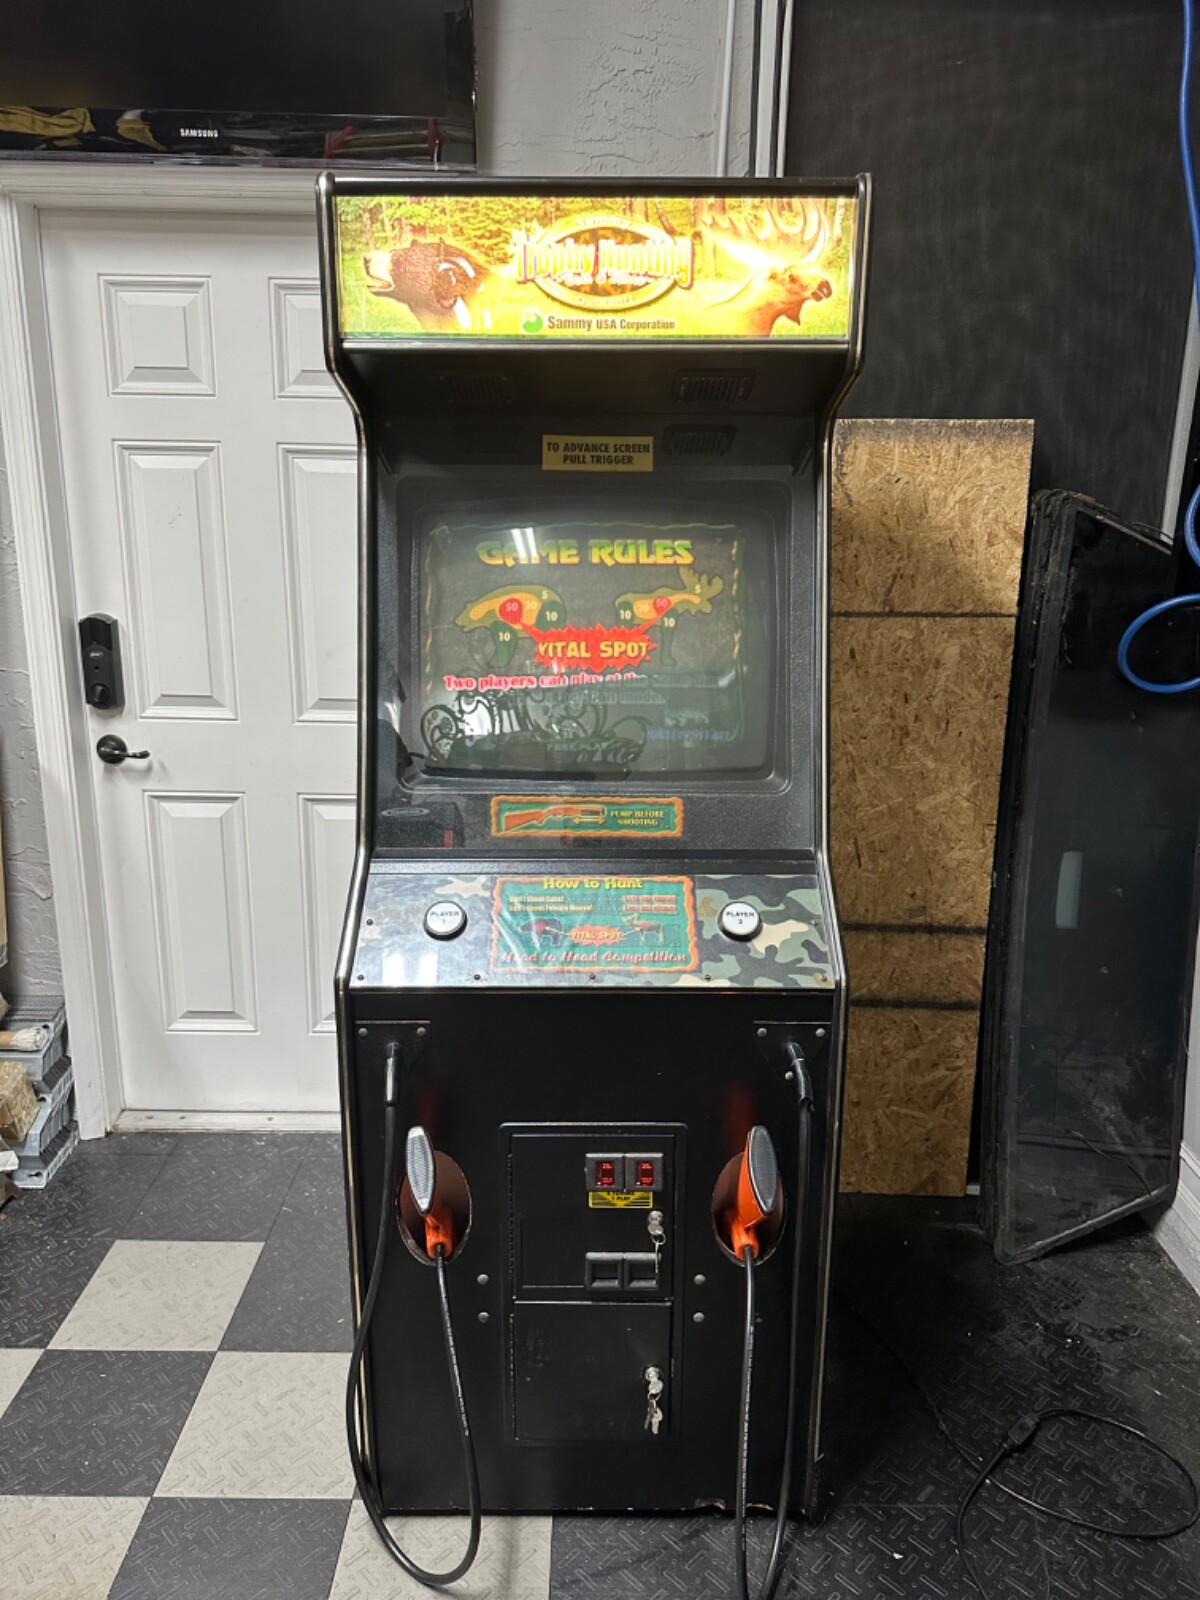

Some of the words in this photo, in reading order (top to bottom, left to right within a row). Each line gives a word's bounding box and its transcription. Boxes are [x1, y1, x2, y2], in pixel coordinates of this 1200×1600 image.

[180, 128, 219, 137] SAMSUNG
[547, 315, 592, 332] Sammy
[596, 319, 617, 330] USA
[620, 318, 675, 331] Corporation
[546, 442, 560, 452] TO
[563, 442, 610, 453] ADVANCE
[613, 443, 650, 453] SCREEN
[563, 455, 587, 464] PULL
[590, 455, 634, 465] TRIGGER
[477, 540, 580, 568] GAME
[588, 538, 695, 568] RULES
[542, 590, 549, 600] 5
[505, 602, 519, 611] 50
[546, 611, 558, 621] 10
[620, 609, 632, 620] 10
[663, 617, 676, 628] 10
[498, 631, 511, 642] 10
[539, 641, 591, 658] VITAL
[599, 641, 648, 658] SPOT
[443, 675, 476, 691] Two
[478, 674, 537, 692] players
[540, 674, 569, 687] can
[543, 879, 580, 889] How
[584, 880, 599, 889] to
[604, 879, 643, 889] Hunt
[501, 951, 538, 961] Had
[543, 951, 556, 961] to
[561, 950, 598, 962] Head
[602, 951, 686, 965] Competition
